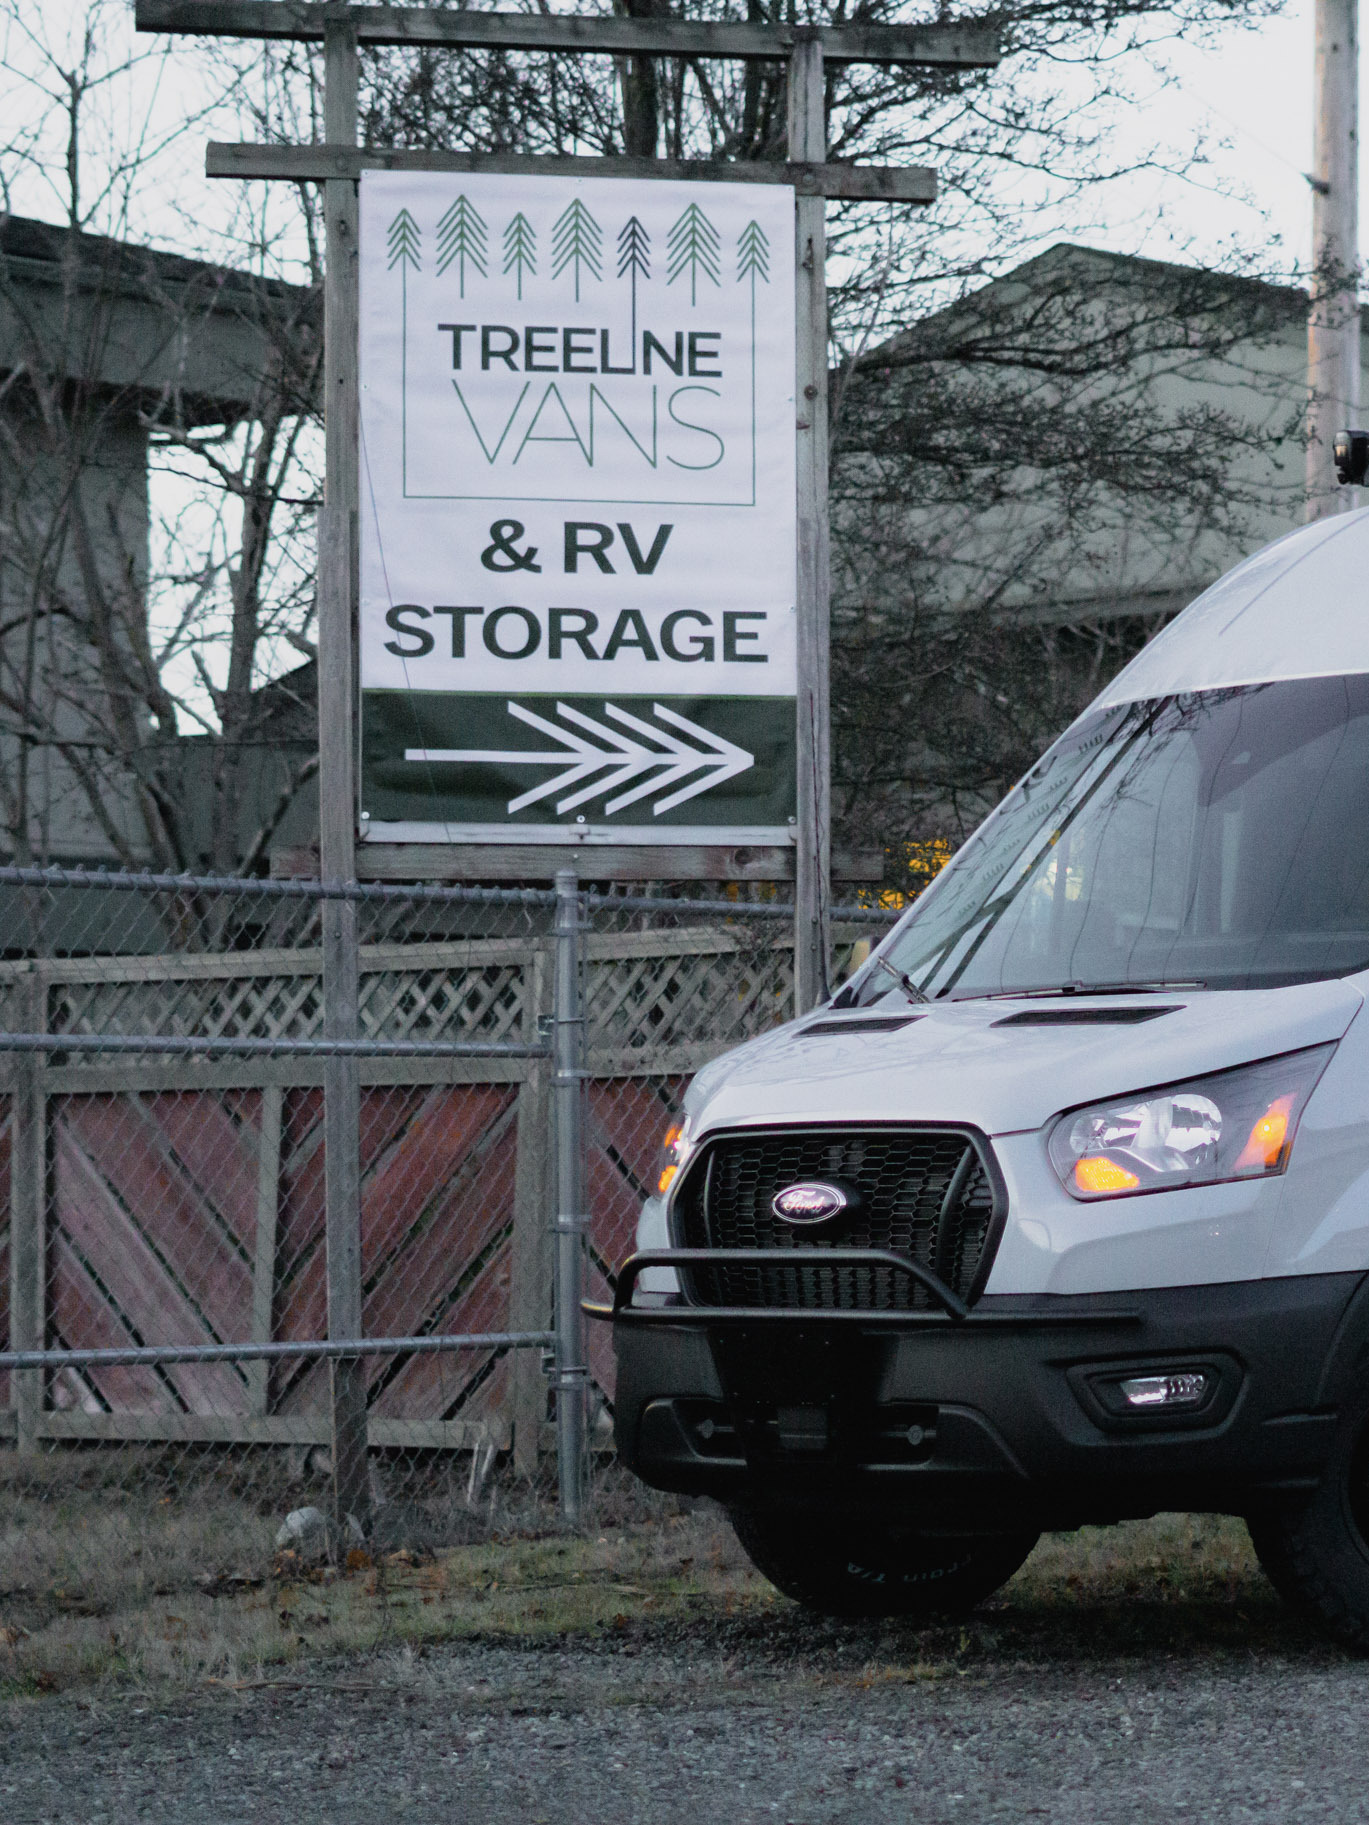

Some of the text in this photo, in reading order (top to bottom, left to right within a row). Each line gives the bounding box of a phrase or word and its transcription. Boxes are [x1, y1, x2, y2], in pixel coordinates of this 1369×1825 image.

[437, 323, 722, 378] TREELINE
[452, 379, 724, 470] VANS
[480, 518, 674, 575] & RV
[384, 604, 769, 664] STORAGE
